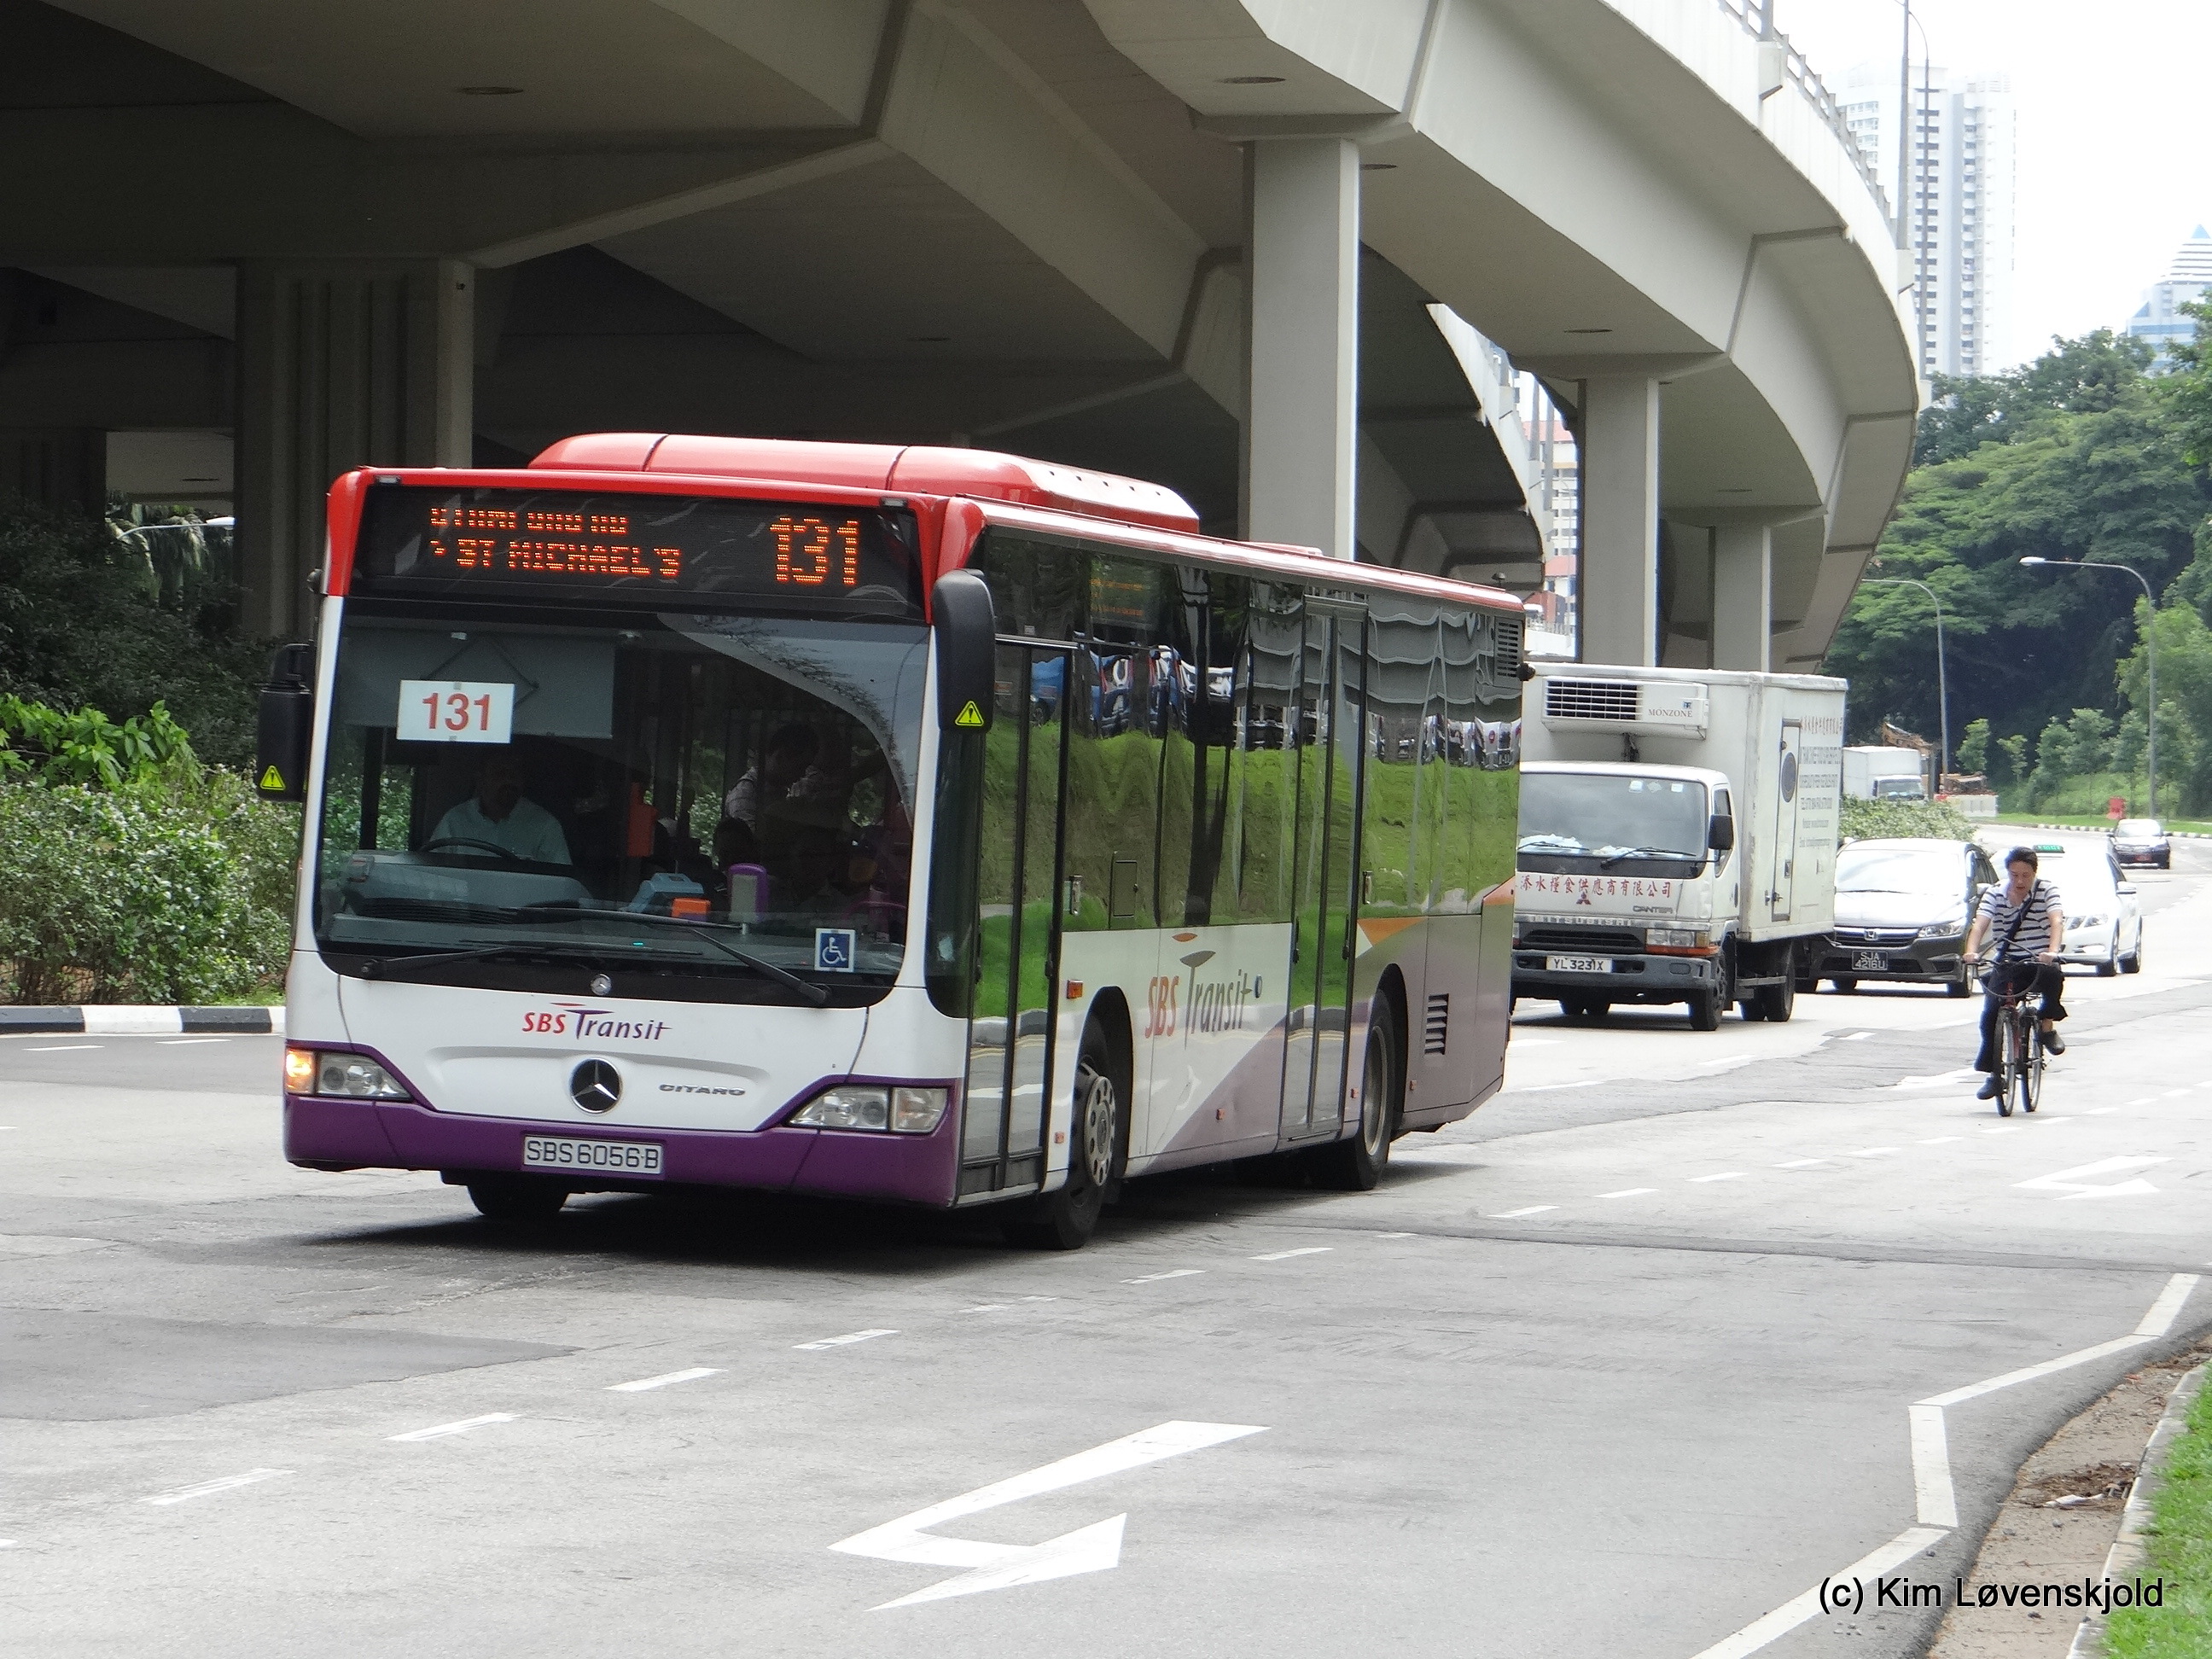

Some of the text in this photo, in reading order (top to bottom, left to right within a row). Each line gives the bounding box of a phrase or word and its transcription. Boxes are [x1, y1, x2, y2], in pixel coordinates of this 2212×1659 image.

[457, 539, 495, 567] ST
[770, 517, 859, 584] 131
[422, 693, 490, 731] 131
[1648, 709, 1693, 718] MONZONE
[1633, 905, 1674, 914] CANTER
[1534, 916, 1632, 926] MITSUBISHI
[1860, 952, 1880, 961] SJA
[1144, 950, 1253, 1051] SBS Transit
[521, 1009, 672, 1040] SBS Transit
[659, 1084, 746, 1096] CITARO
